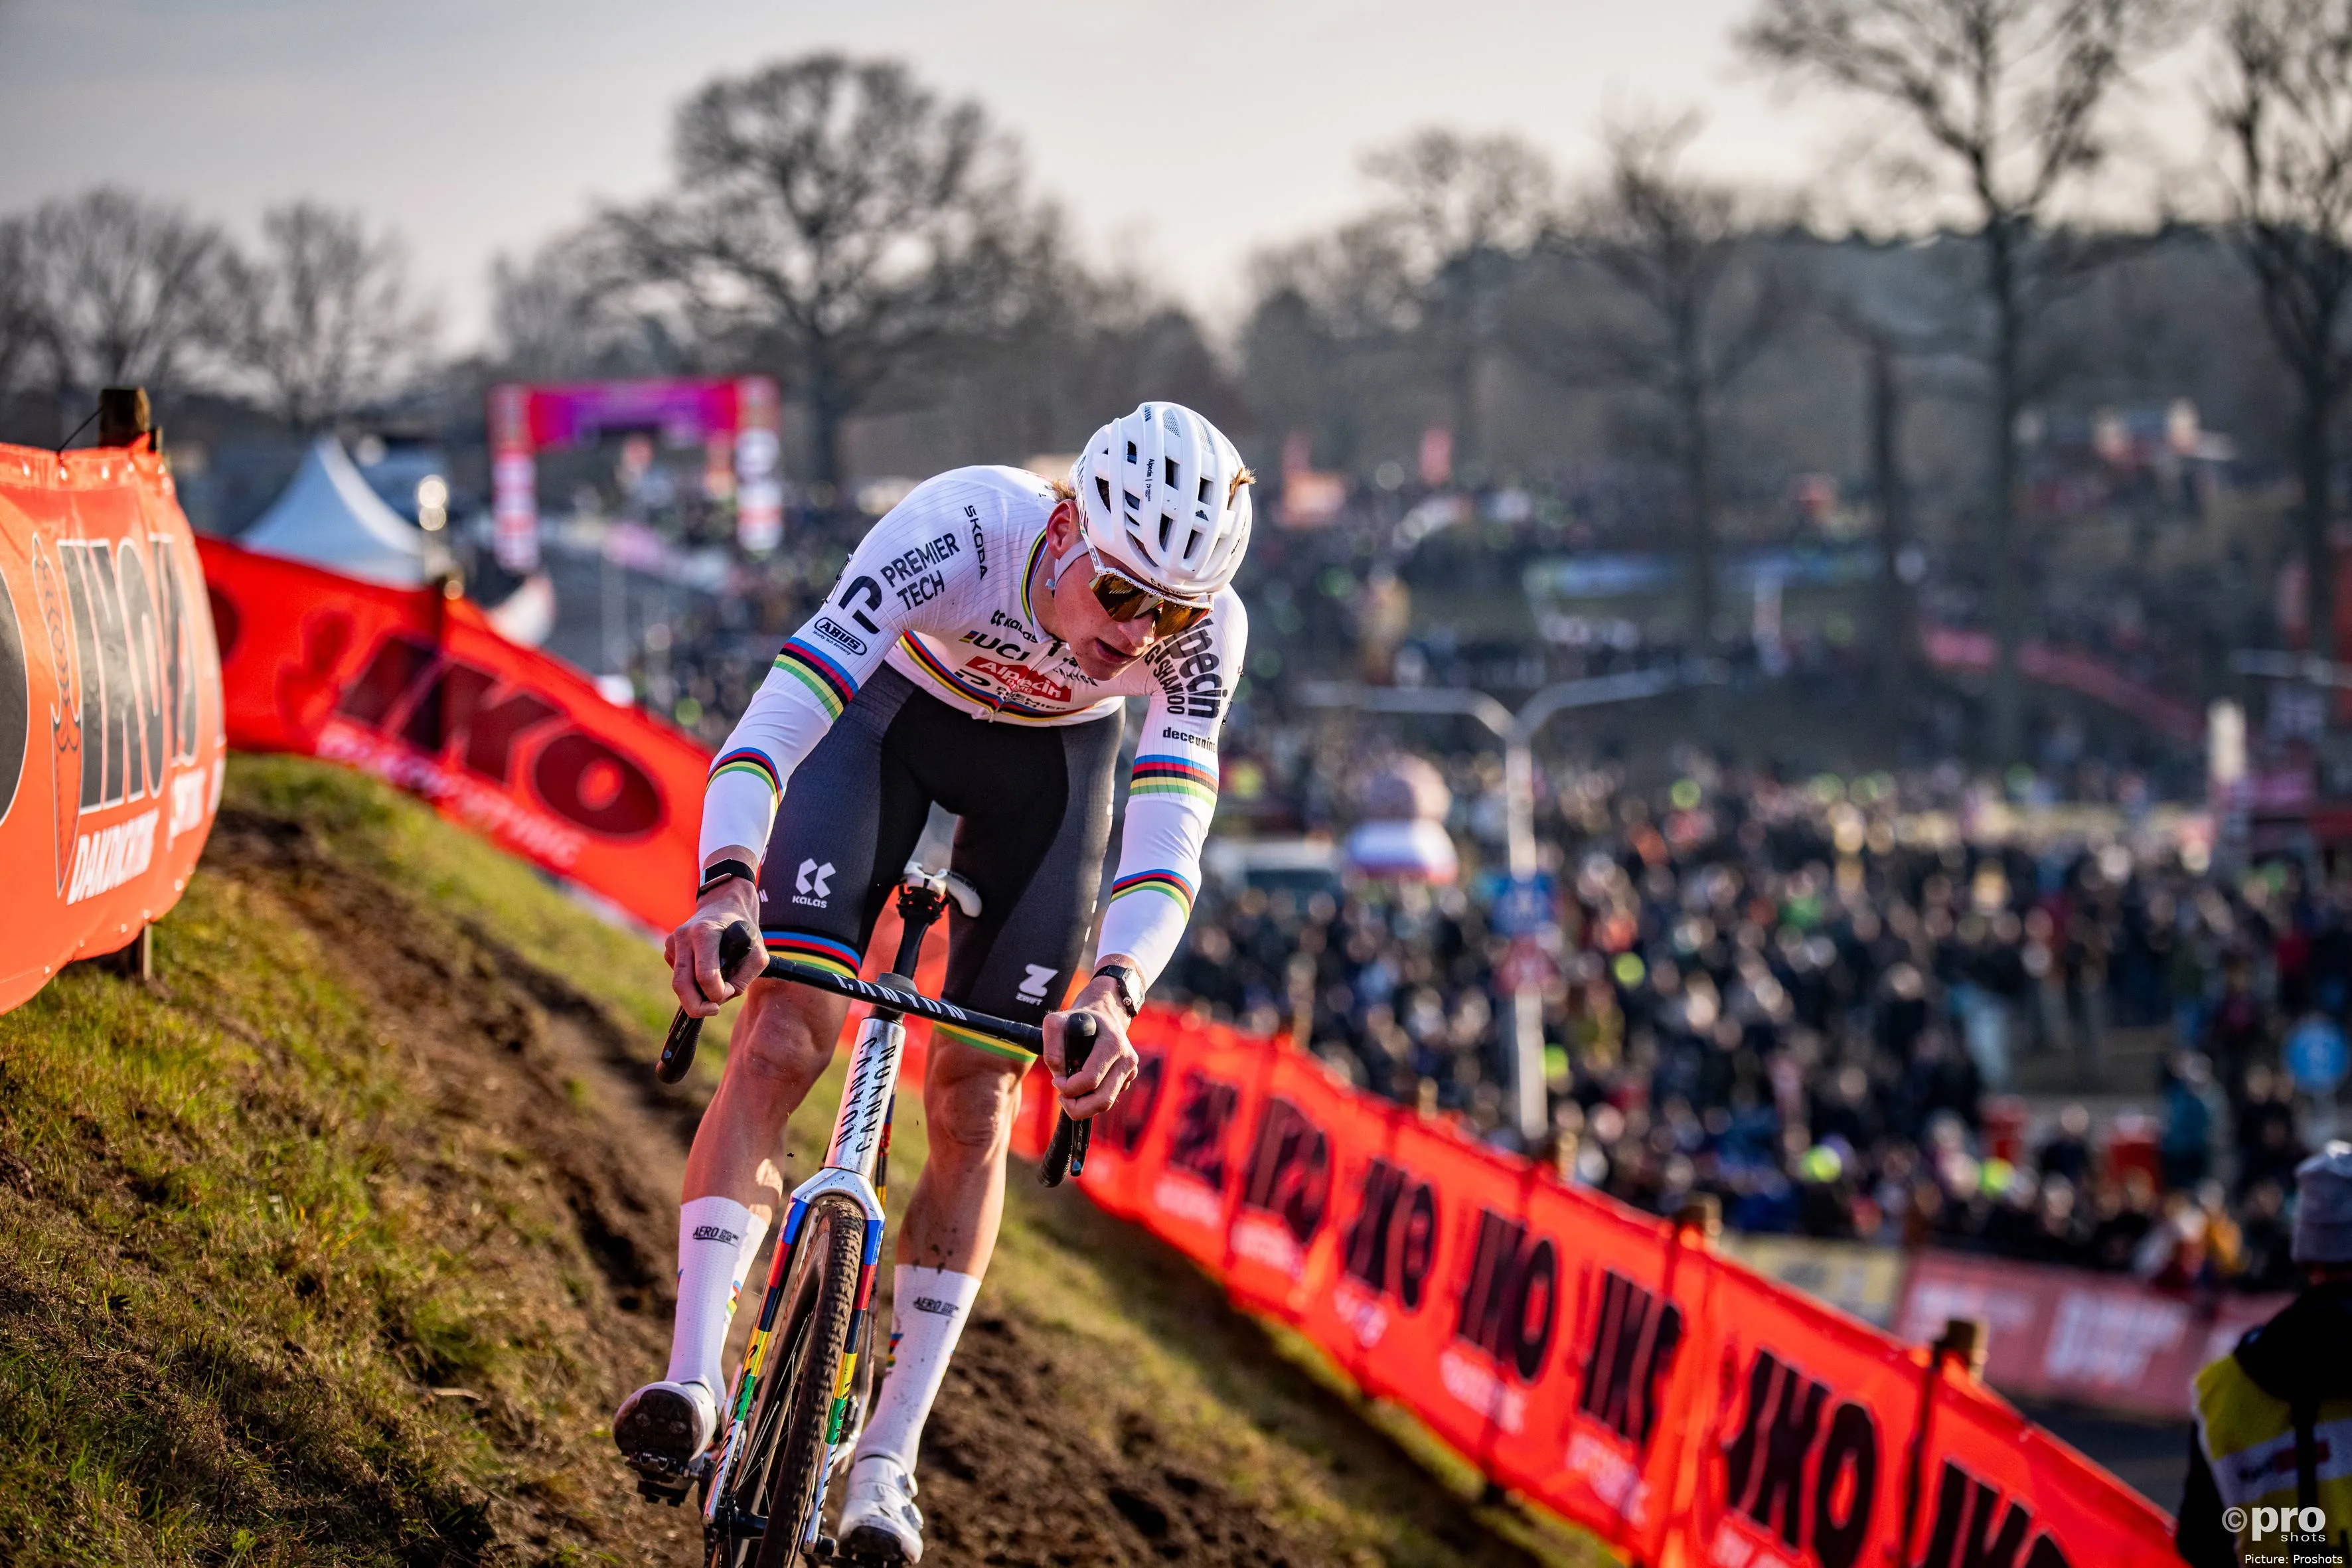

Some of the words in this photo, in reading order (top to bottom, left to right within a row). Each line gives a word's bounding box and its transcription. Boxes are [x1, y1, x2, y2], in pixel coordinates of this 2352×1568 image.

[880, 532, 961, 588] PREMIER
[896, 570, 945, 611] TECH
[819, 621, 861, 651] ABUS
[972, 633, 1031, 661] UCI
[977, 661, 1062, 698] Alpecin
[1152, 659, 1186, 715] SHAMOO
[1162, 618, 1228, 719] lpecin
[1163, 726, 1217, 753] deceunin
[832, 973, 967, 1021] CANYON
[1015, 992, 1043, 1006] ZWIFT
[835, 1036, 878, 1149] CANYON
[855, 1044, 898, 1153] CANYON
[692, 1225, 720, 1240] AERO
